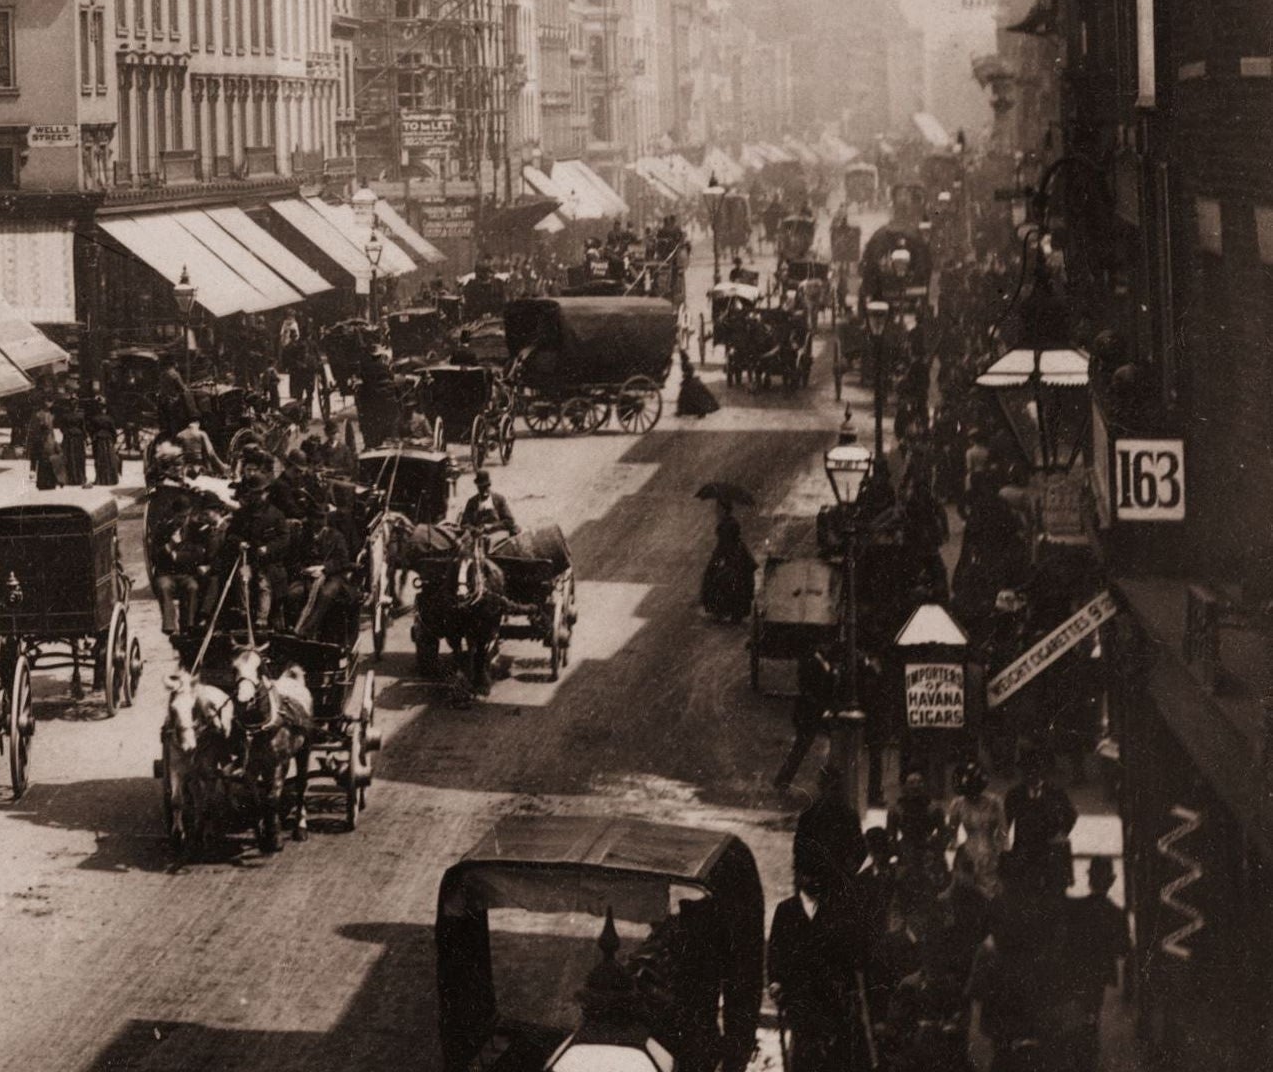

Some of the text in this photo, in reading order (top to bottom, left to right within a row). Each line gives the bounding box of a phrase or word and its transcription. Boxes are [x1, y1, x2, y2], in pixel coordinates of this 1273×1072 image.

[34, 126, 70, 134] WELLS
[1117, 450, 1181, 508] 163
[906, 666, 964, 690] IMPORTERS
[908, 691, 963, 706] HAVANA
[909, 709, 963, 725] CIGARS
